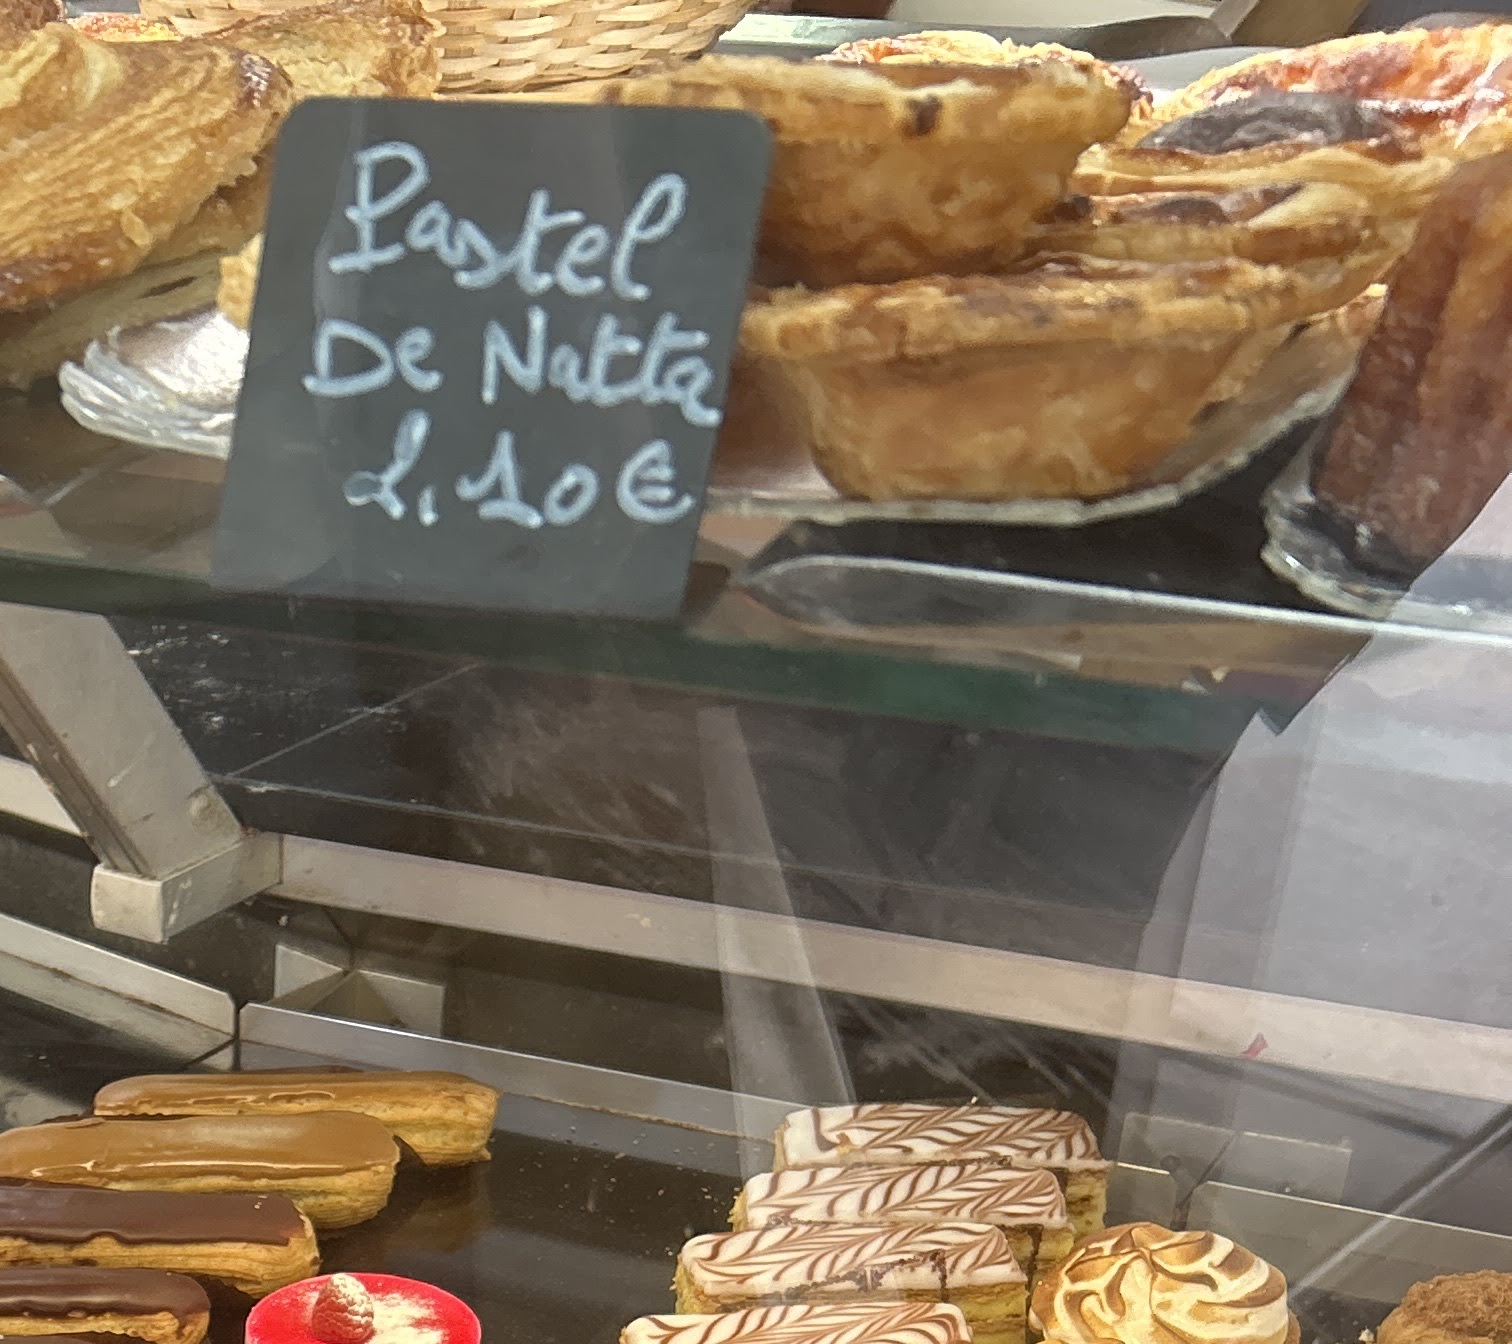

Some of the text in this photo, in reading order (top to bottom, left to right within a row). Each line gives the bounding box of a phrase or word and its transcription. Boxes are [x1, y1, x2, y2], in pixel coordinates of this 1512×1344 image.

[328, 141, 687, 300] Pastel
[302, 305, 724, 428] De Natta
